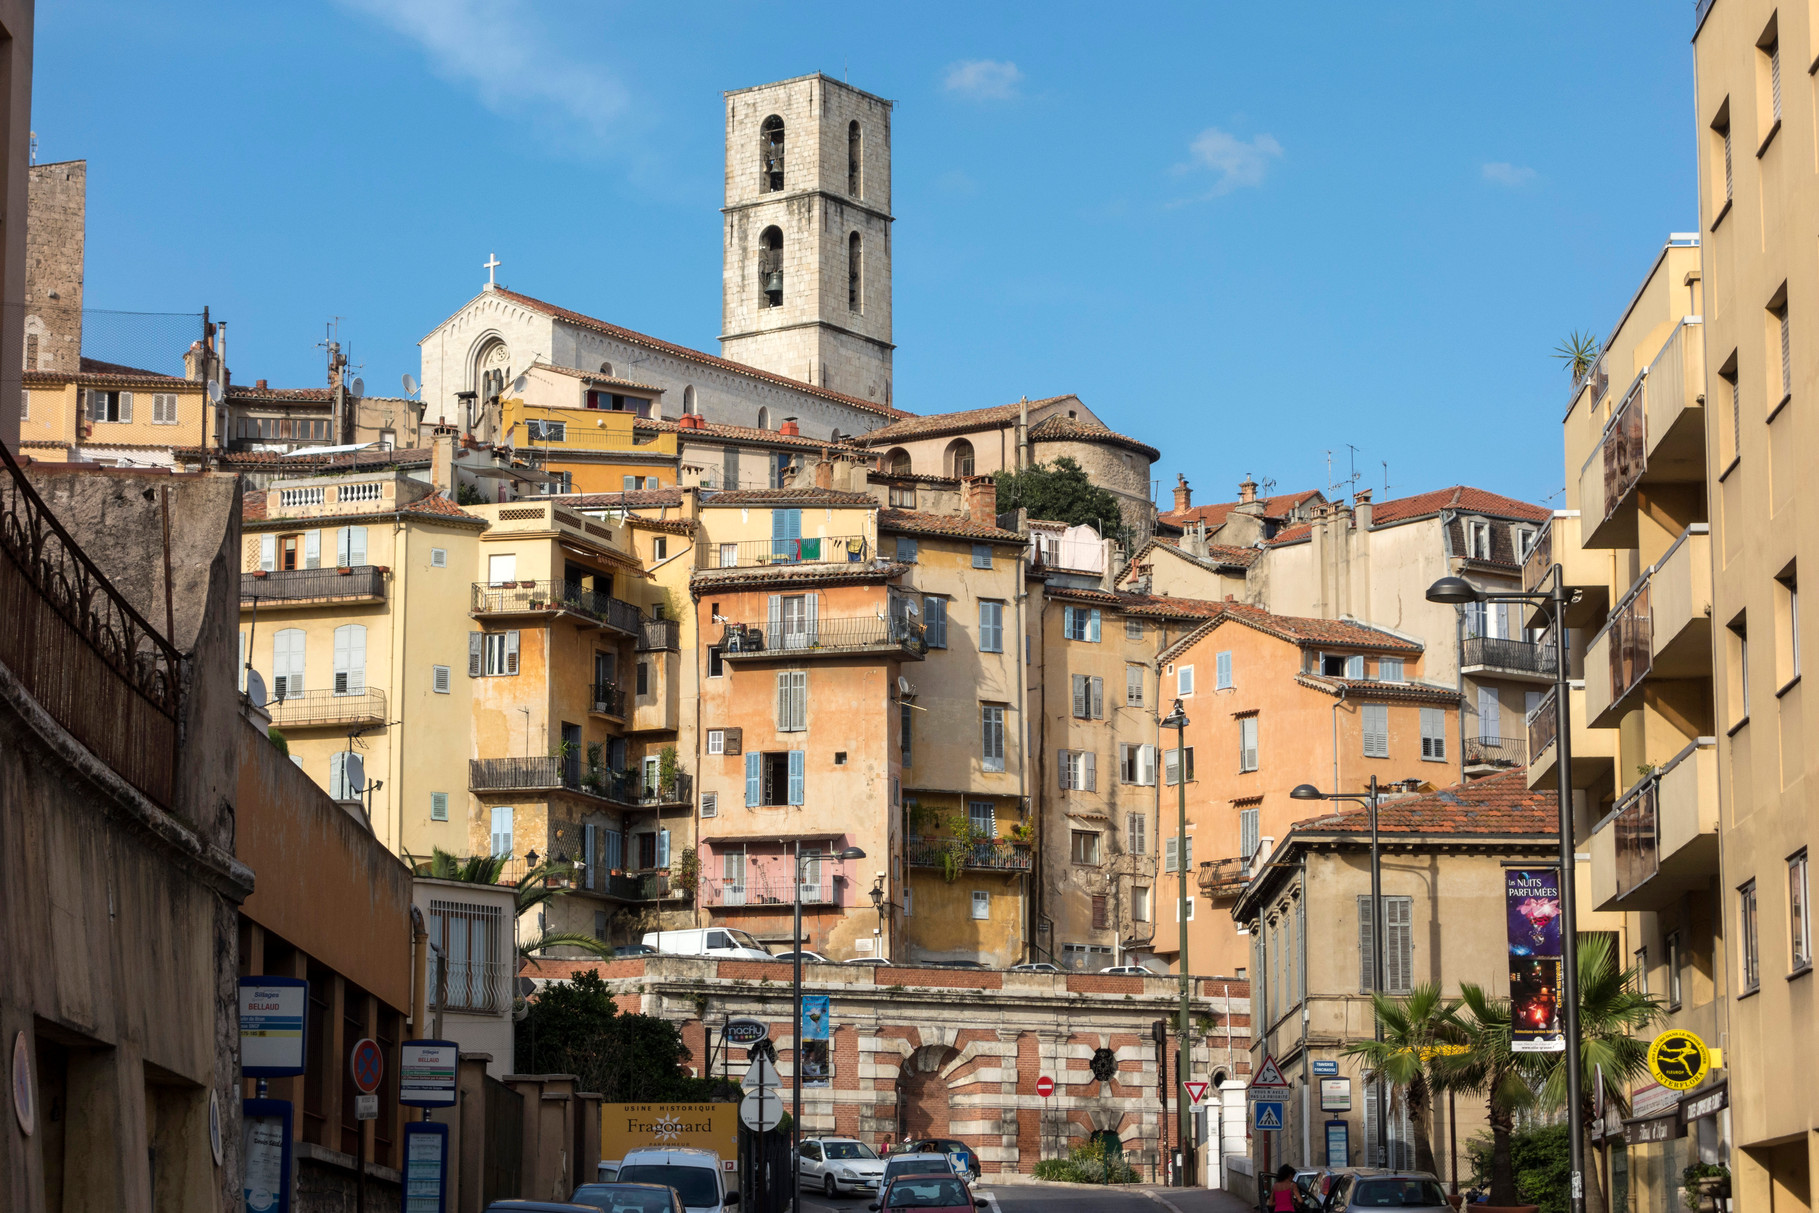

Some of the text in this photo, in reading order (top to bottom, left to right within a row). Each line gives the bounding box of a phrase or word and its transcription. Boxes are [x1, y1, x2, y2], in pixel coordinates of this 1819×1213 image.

[1517, 878, 1542, 887] NUITS
[1508, 887, 1558, 897] PARFUMÉES
[248, 1003, 280, 1011] BELLAUD
[726, 1024, 763, 1037] macfly
[1655, 1071, 1704, 1088] INTERFLORA
[627, 1118, 712, 1135] Fragonard
